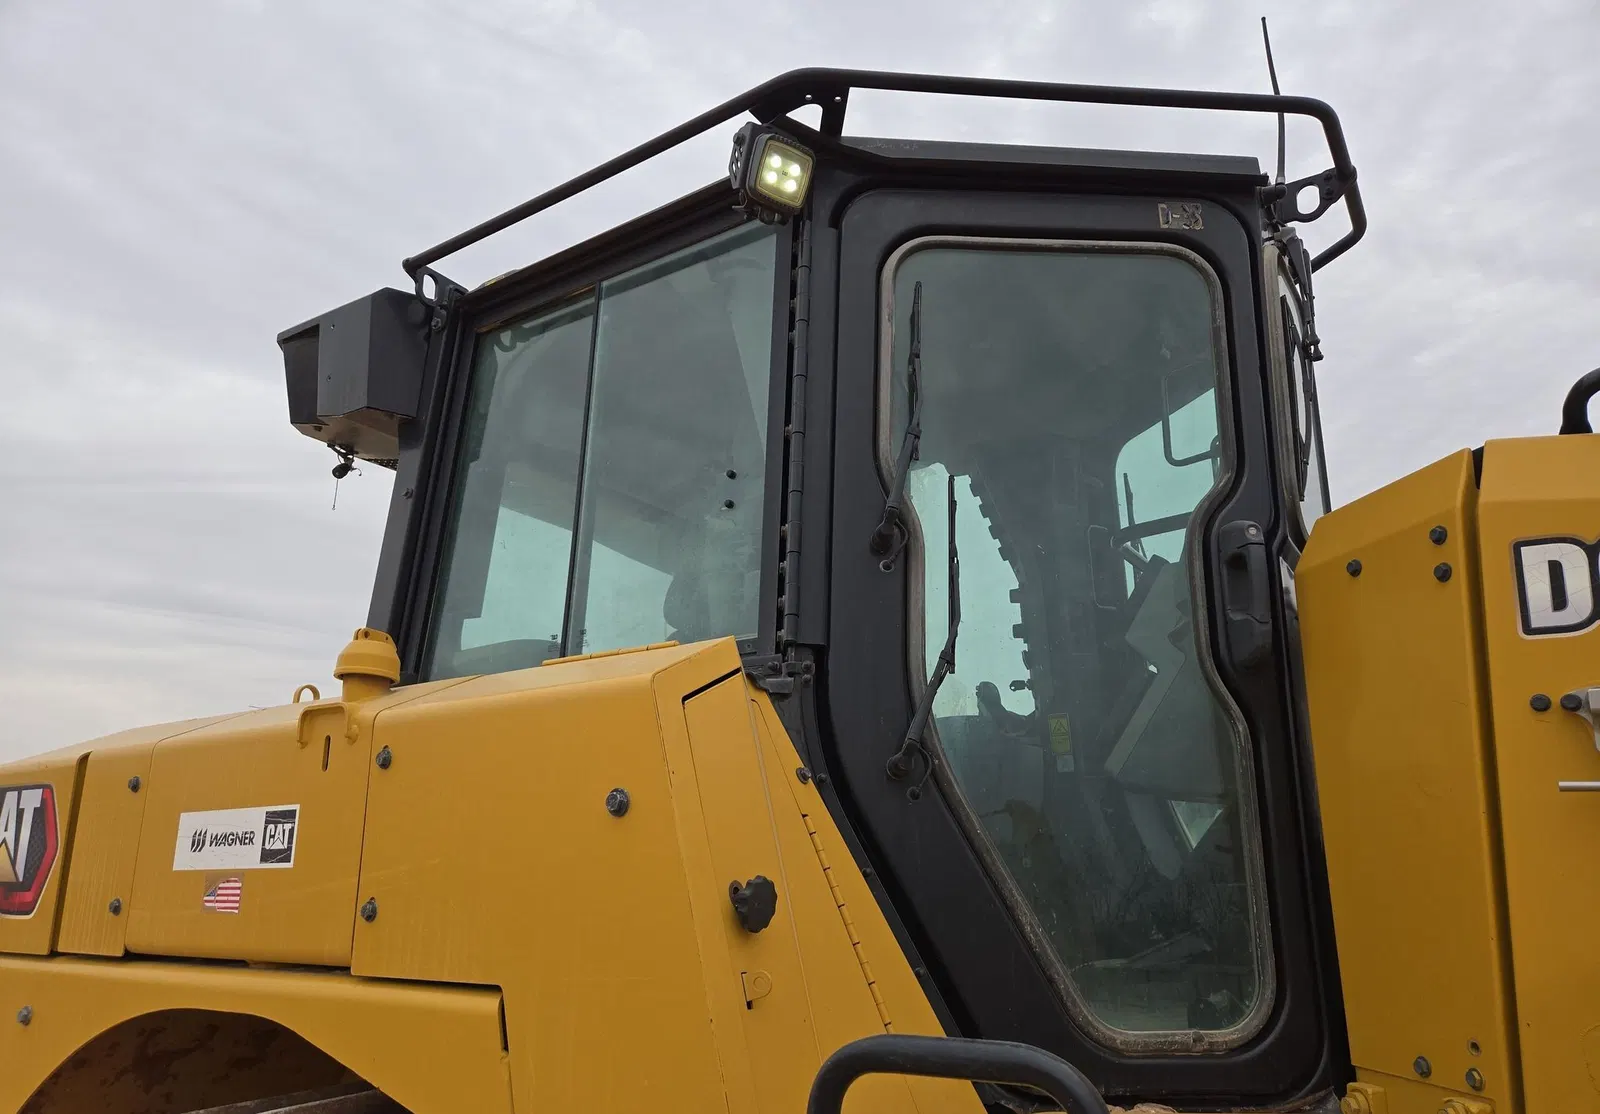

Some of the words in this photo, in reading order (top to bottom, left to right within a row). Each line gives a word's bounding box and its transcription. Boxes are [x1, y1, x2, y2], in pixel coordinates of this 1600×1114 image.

[1520, 542, 1600, 628] D
[0, 788, 43, 882] AT
[209, 831, 256, 848] WAGNER
[265, 823, 293, 850] CAT
